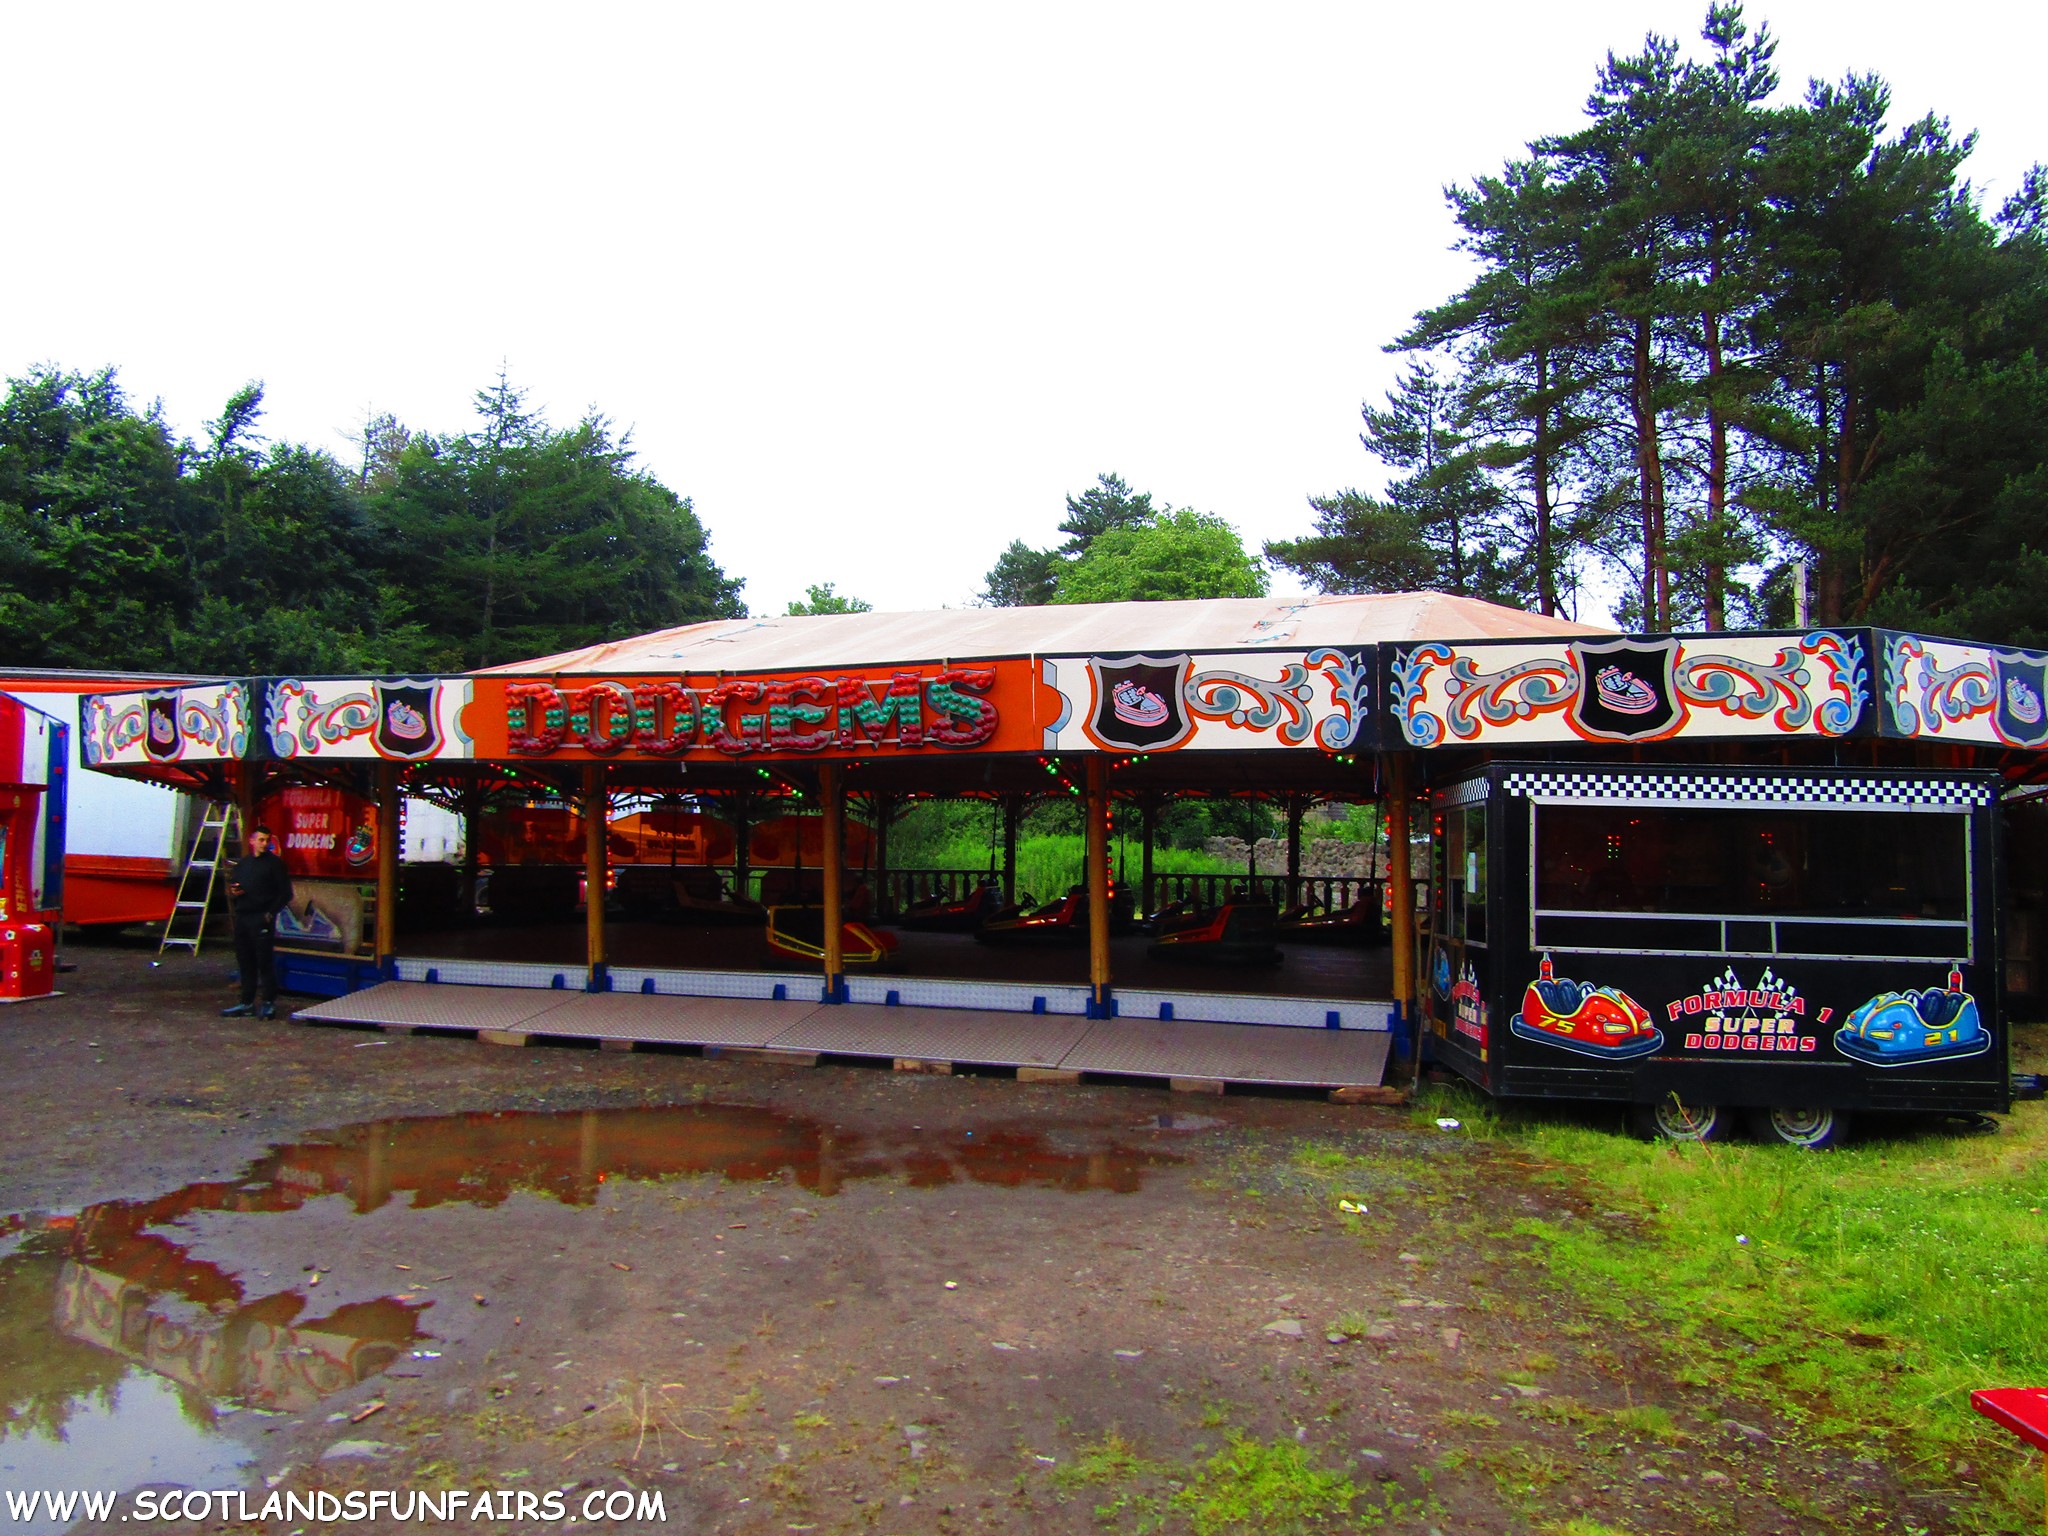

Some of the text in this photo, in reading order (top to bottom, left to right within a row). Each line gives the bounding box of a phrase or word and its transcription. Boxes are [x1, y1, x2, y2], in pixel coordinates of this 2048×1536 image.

[504, 667, 999, 756] DODGEMS
[295, 812, 329, 829] SUPER
[286, 832, 337, 850] DODGEMS
[1666, 989, 1833, 1024] FORMULA 1
[1538, 1015, 1576, 1034] 75
[1704, 1016, 1795, 1034] SUPER
[1684, 1033, 1816, 1051] DODGEMS
[1924, 1029, 1958, 1046] 21
